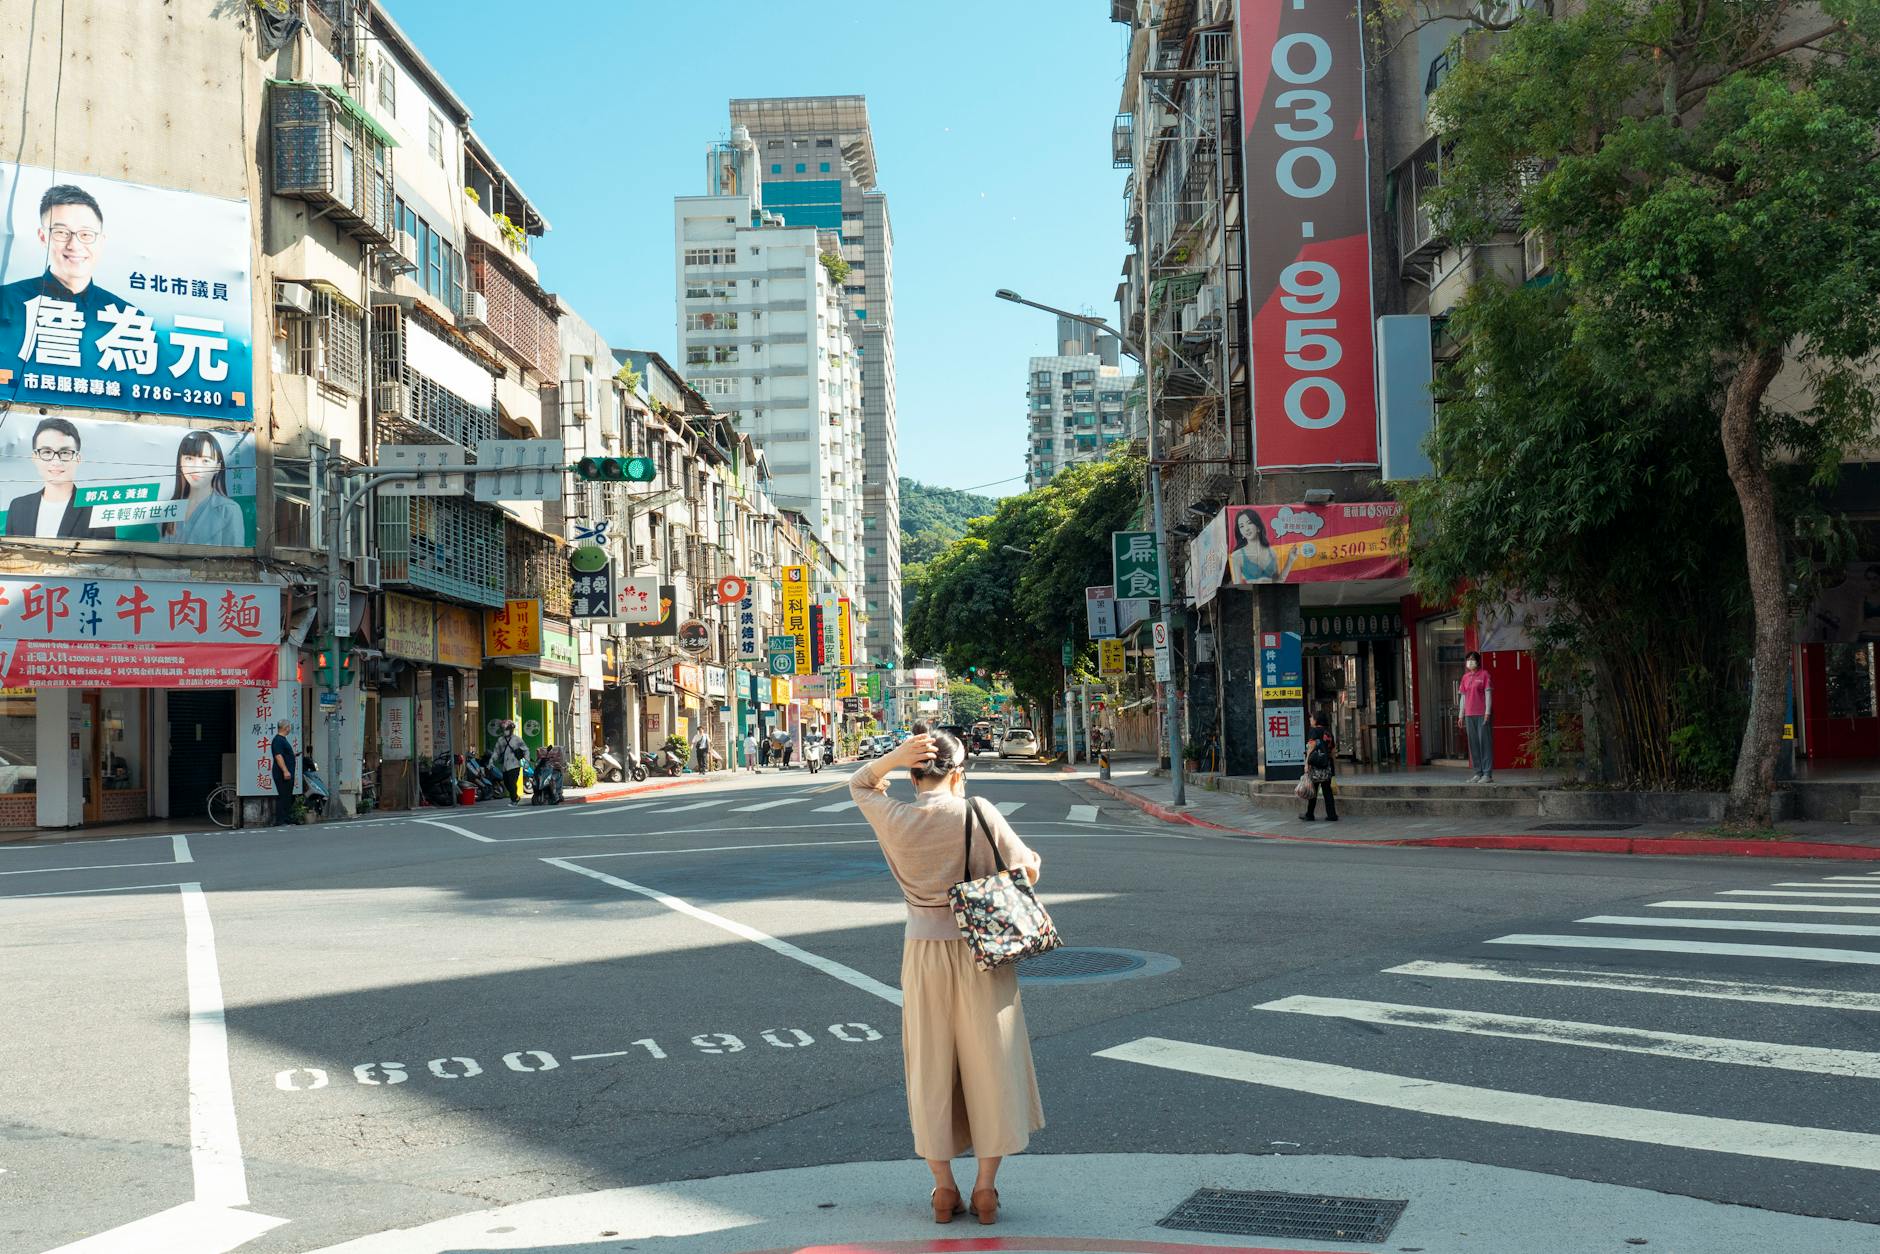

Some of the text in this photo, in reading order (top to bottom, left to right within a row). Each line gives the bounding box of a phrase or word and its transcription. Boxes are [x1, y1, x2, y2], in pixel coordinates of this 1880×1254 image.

[129, 271, 229, 301] 台北市議員
[18, 295, 229, 382] 詹為元
[24, 373, 222, 406] 市民服務專線 8786-3280
[85, 490, 109, 502] 郭凡
[112, 490, 121, 500] &
[101, 504, 178, 521] 年輕新世代
[1119, 534, 1157, 597] 扁食
[1331, 540, 1366, 560] 3500
[79, 582, 103, 636] 原汁
[115, 584, 263, 637] 牛肉麵
[515, 601, 530, 651] 四川涼麵
[27, 665, 67, 675] 計時人員
[252, 723, 276, 735] 原汁
[1268, 715, 1290, 737] 租
[256, 736, 273, 790] 牛肉麵
[275, 1021, 885, 1093] 0600-1900
